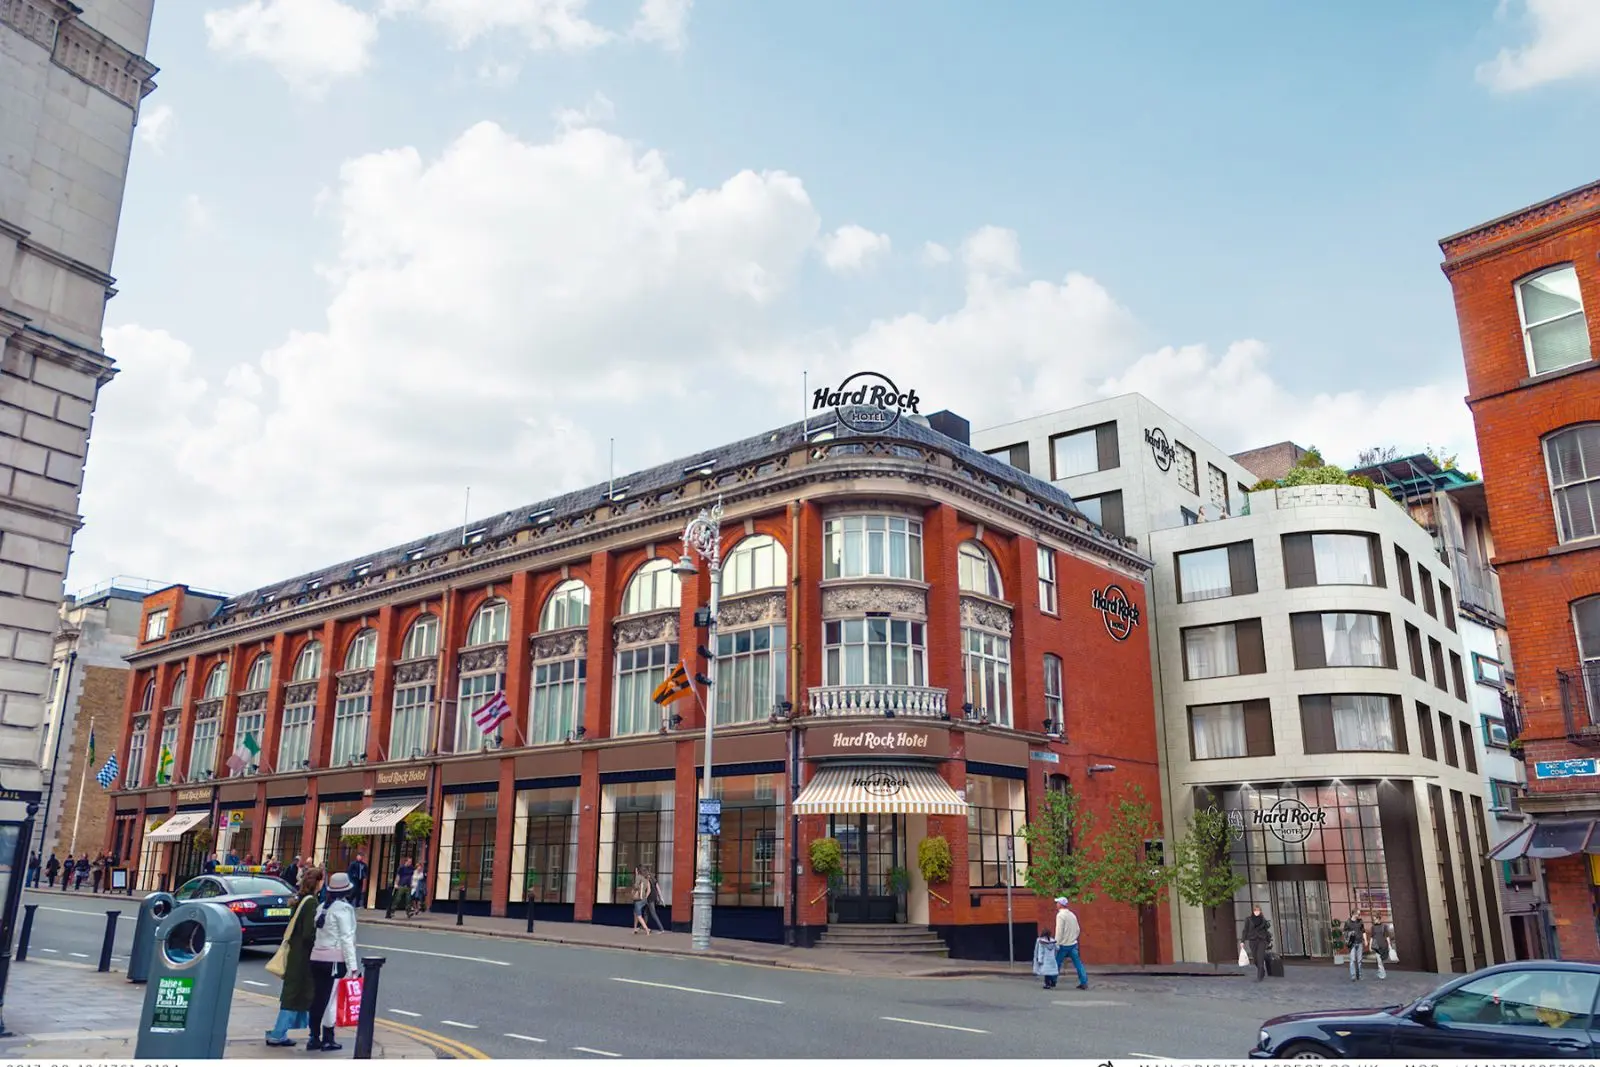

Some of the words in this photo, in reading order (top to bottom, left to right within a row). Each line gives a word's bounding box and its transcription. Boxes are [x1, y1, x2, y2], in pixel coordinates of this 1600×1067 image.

[812, 384, 868, 410] Hard
[870, 384, 920, 414] Rock
[852, 413, 885, 421] HOTEL
[1144, 428, 1161, 450] Hard
[1161, 440, 1176, 464] Rock
[1091, 589, 1118, 615] Hard
[1116, 597, 1140, 627] Rock
[833, 732, 864, 747] Hard
[864, 731, 895, 749] Rock
[896, 732, 928, 748] Hotel
[377, 772, 393, 784] Hard
[393, 771, 409, 785] Rock
[408, 770, 427, 781] Hotel
[851, 777, 881, 788] Hard
[882, 777, 910, 789] Rock
[1253, 808, 1289, 824] Hard
[1291, 807, 1327, 826] Rock
